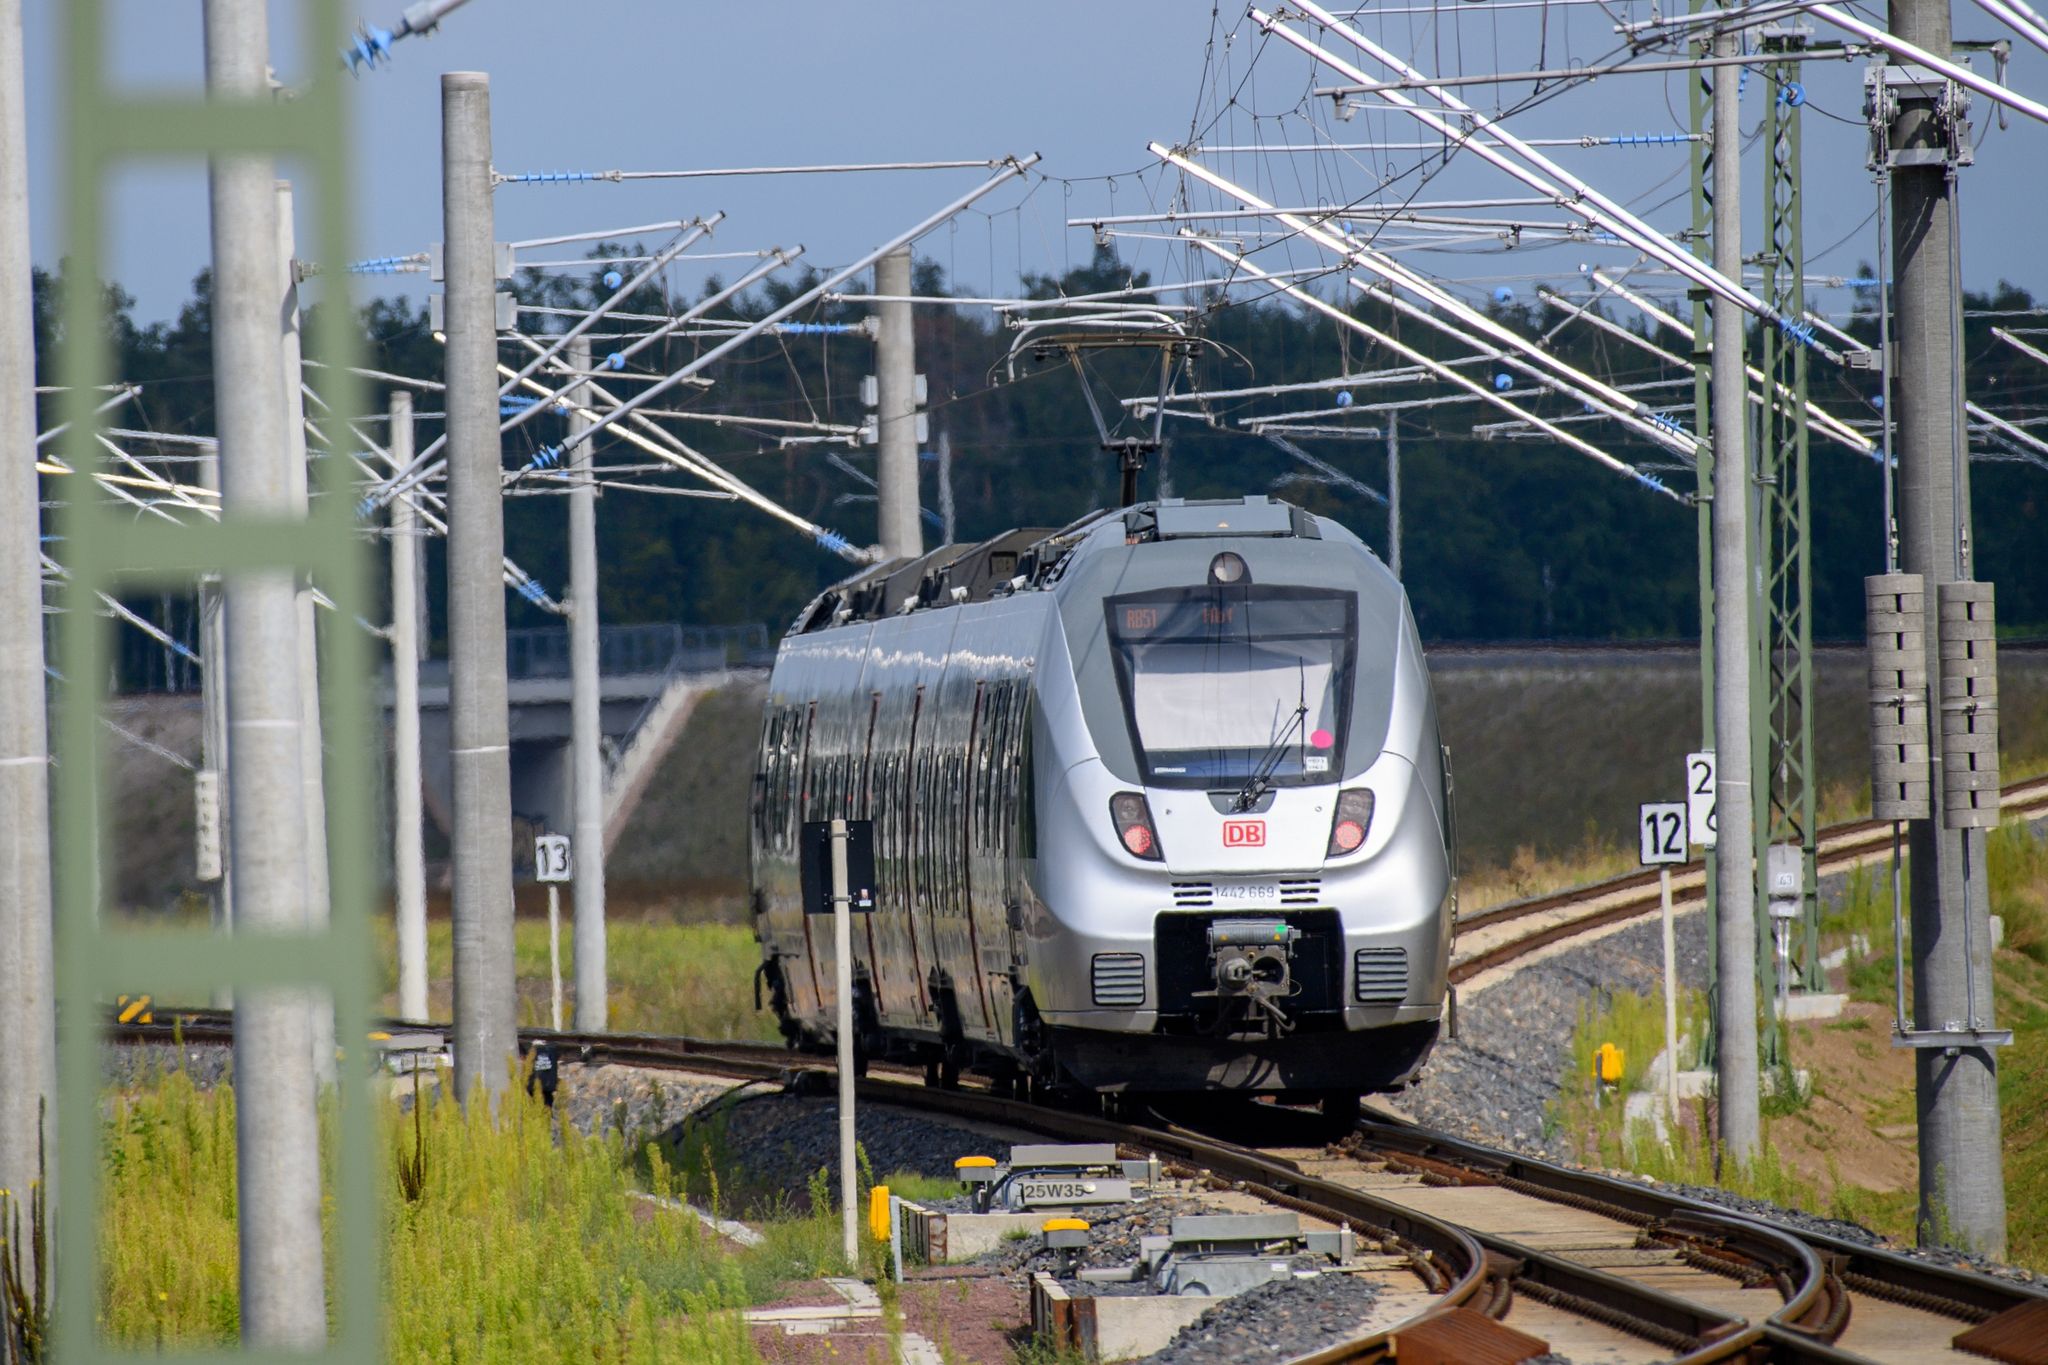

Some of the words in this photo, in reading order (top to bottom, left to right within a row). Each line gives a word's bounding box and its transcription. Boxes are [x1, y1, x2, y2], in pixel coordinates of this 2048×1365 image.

[1692, 761, 1713, 794] 2
[1229, 825, 1261, 842] DB
[1646, 812, 1682, 855] 12
[538, 843, 567, 875] 13
[1215, 887, 1246, 898] 1442
[1249, 886, 1275, 898] 669
[1025, 1183, 1085, 1199] 25W35
